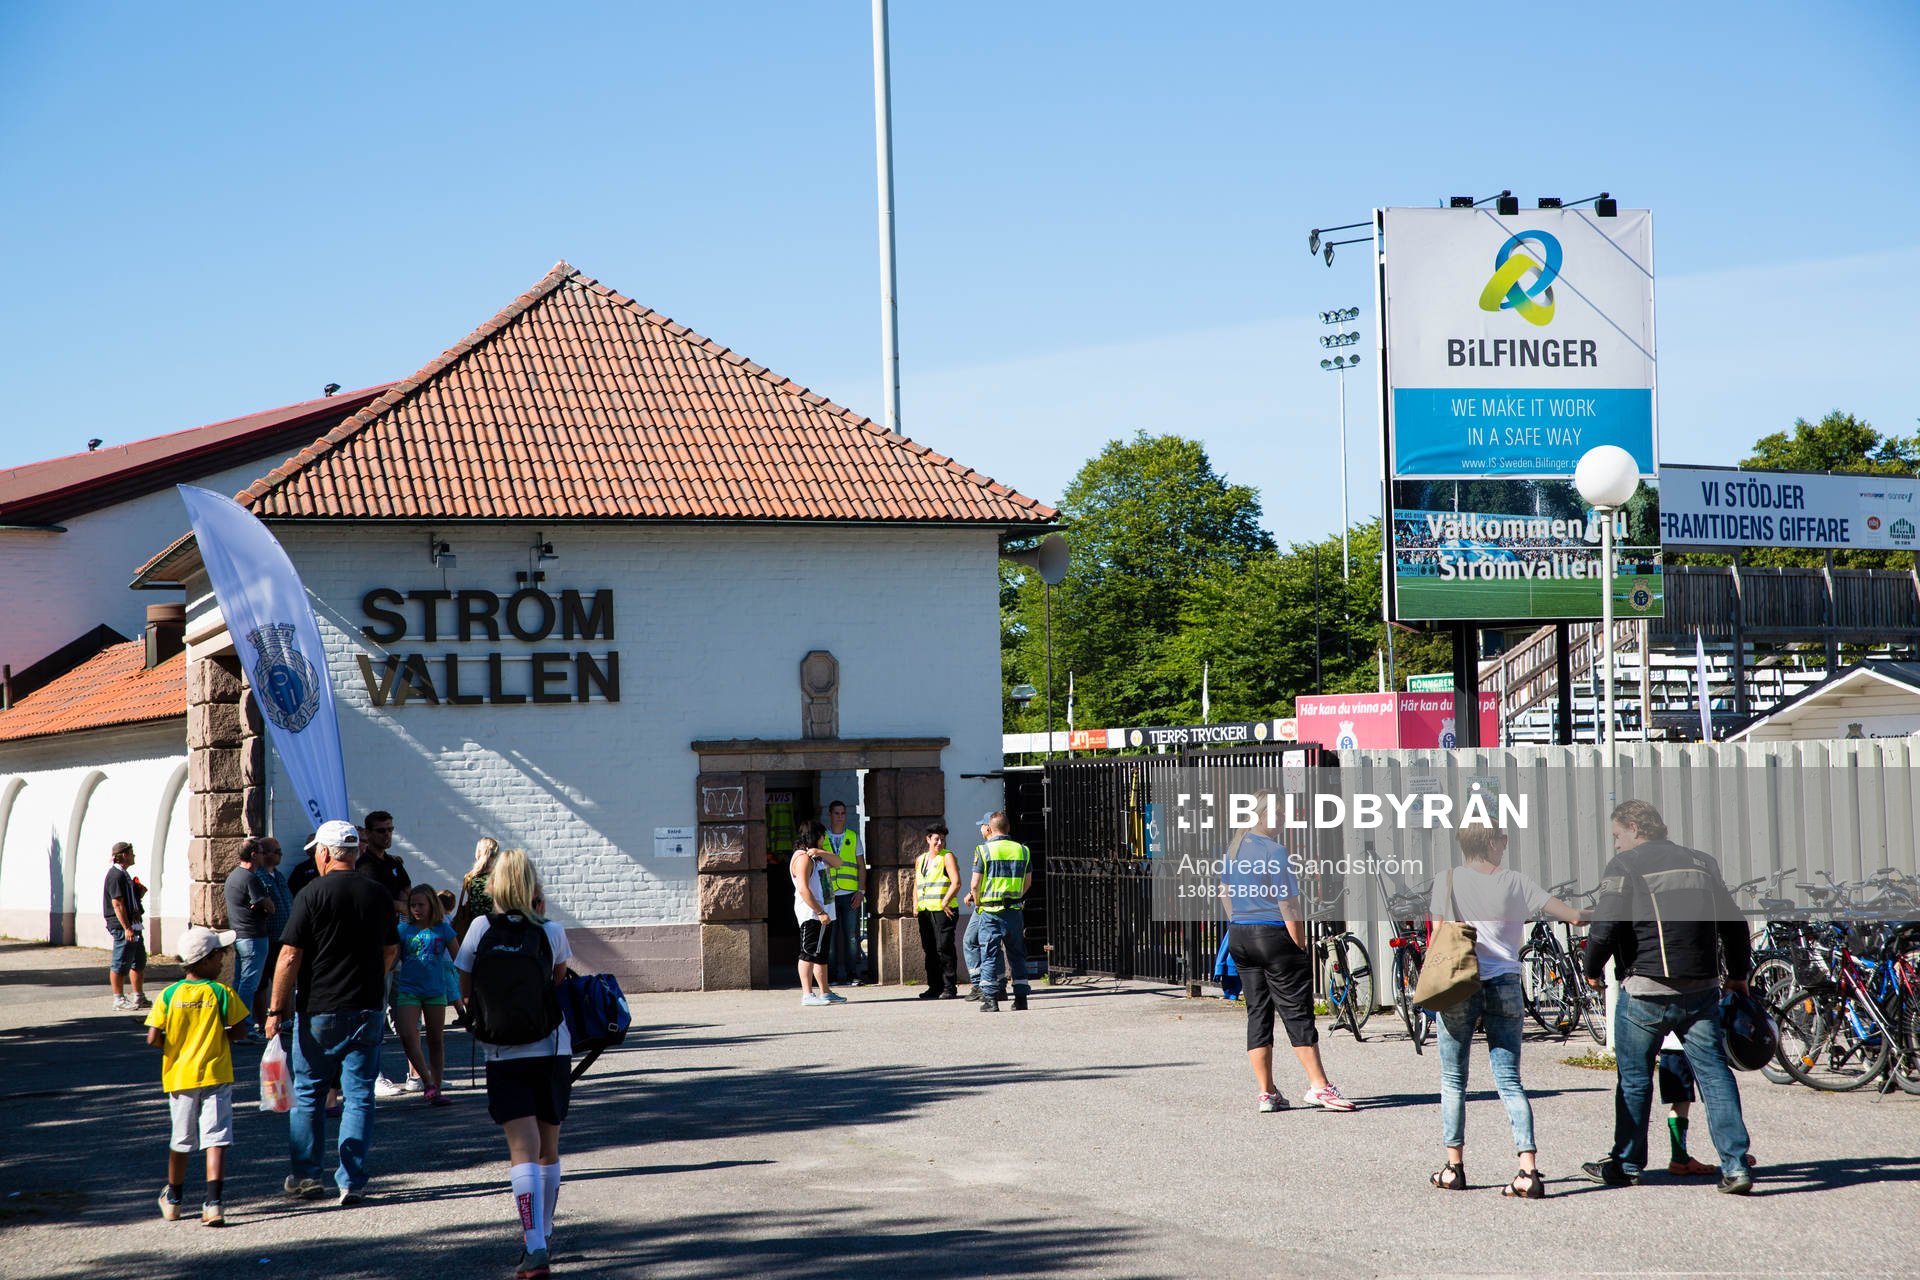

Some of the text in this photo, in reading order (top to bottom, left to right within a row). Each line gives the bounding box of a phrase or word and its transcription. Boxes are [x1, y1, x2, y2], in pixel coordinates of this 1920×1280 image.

[1451, 398, 1597, 417] WE MAKE IT WORK
[1467, 427, 1583, 446] IN A SAFE WAY
[1701, 477, 1805, 509] VI STÖDJER
[1426, 512, 1629, 540] Välkommen tll
[1779, 516, 1850, 543] GIFFARE
[362, 571, 615, 643] STRÖM
[356, 651, 621, 706] VALLEN
[1301, 699, 1394, 716] Här kan du vinna på
[1400, 699, 1453, 712] Här kan du
[1483, 698, 1496, 713] på
[1149, 726, 1247, 744] TIERPS TRYCKERI
